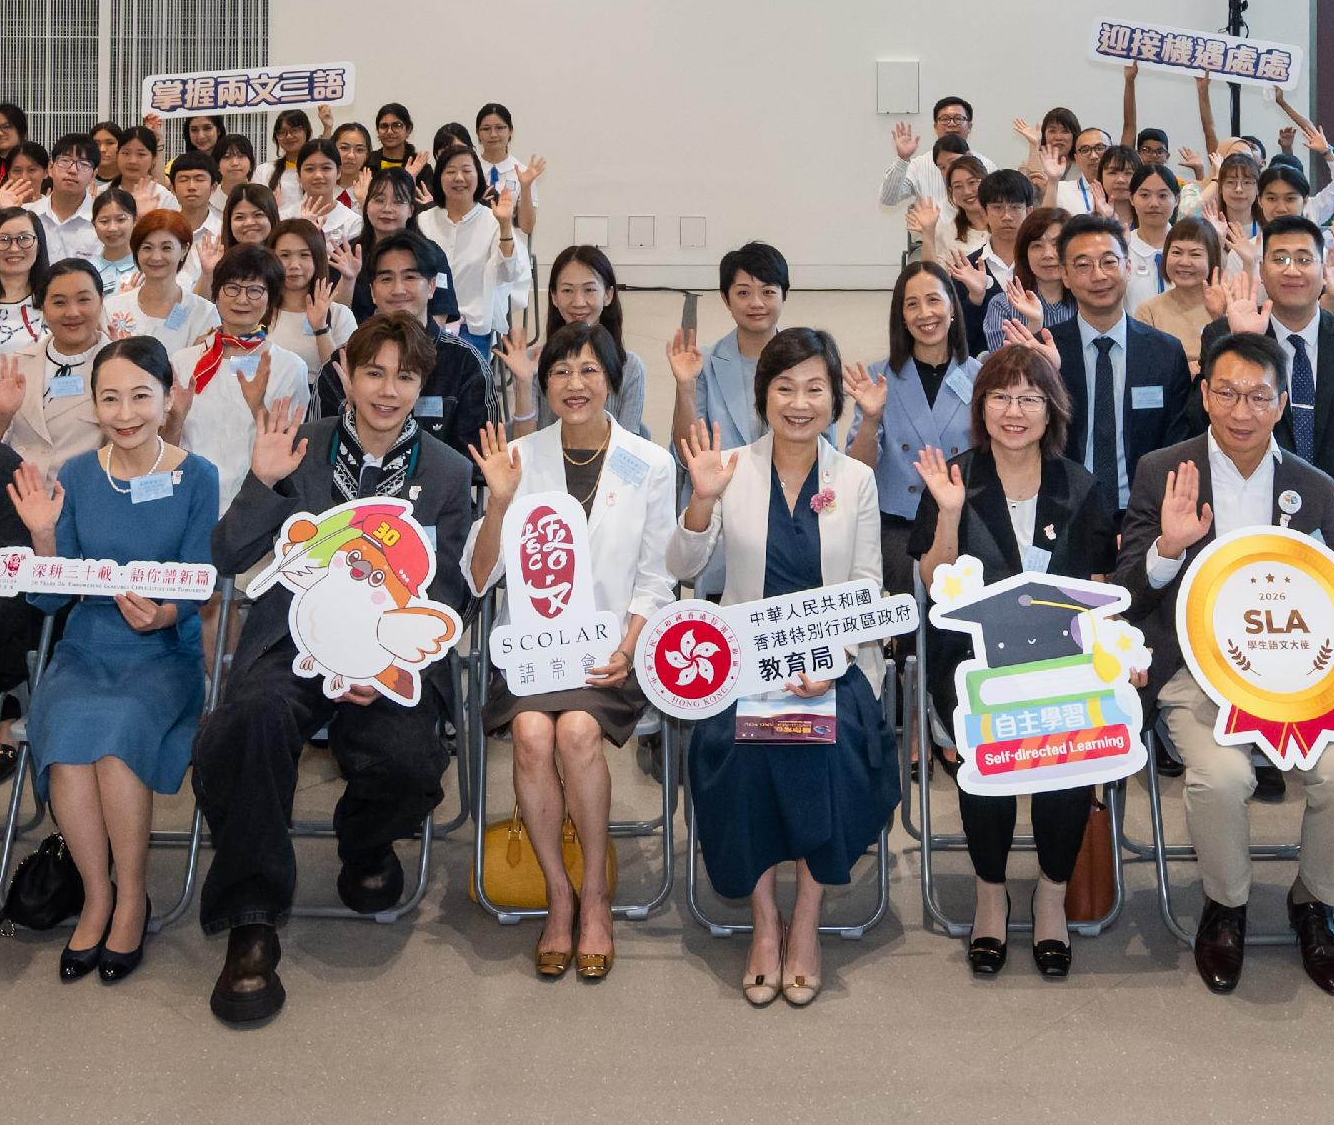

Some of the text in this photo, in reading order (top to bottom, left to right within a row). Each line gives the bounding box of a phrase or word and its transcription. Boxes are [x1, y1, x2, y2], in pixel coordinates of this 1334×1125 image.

[1096, 22, 1292, 82] 迎接機遇處處
[151, 68, 345, 111] 掌握兩文三語
[372, 521, 401, 547] 30
[750, 588, 872, 627] 中華人民共和國
[1258, 592, 1286, 601] 2026
[753, 604, 911, 652] 香港特別行政區政府
[1243, 609, 1311, 634] SLA
[502, 623, 609, 654] SCOLAR
[1247, 639, 1310, 650] 學生語文大使
[518, 653, 597, 685] 語常會
[758, 645, 834, 682] 教育局
[670, 685, 729, 708] HONG KONG
[995, 704, 1087, 738] 自主學習
[984, 735, 1125, 767] Self-directed Learning
